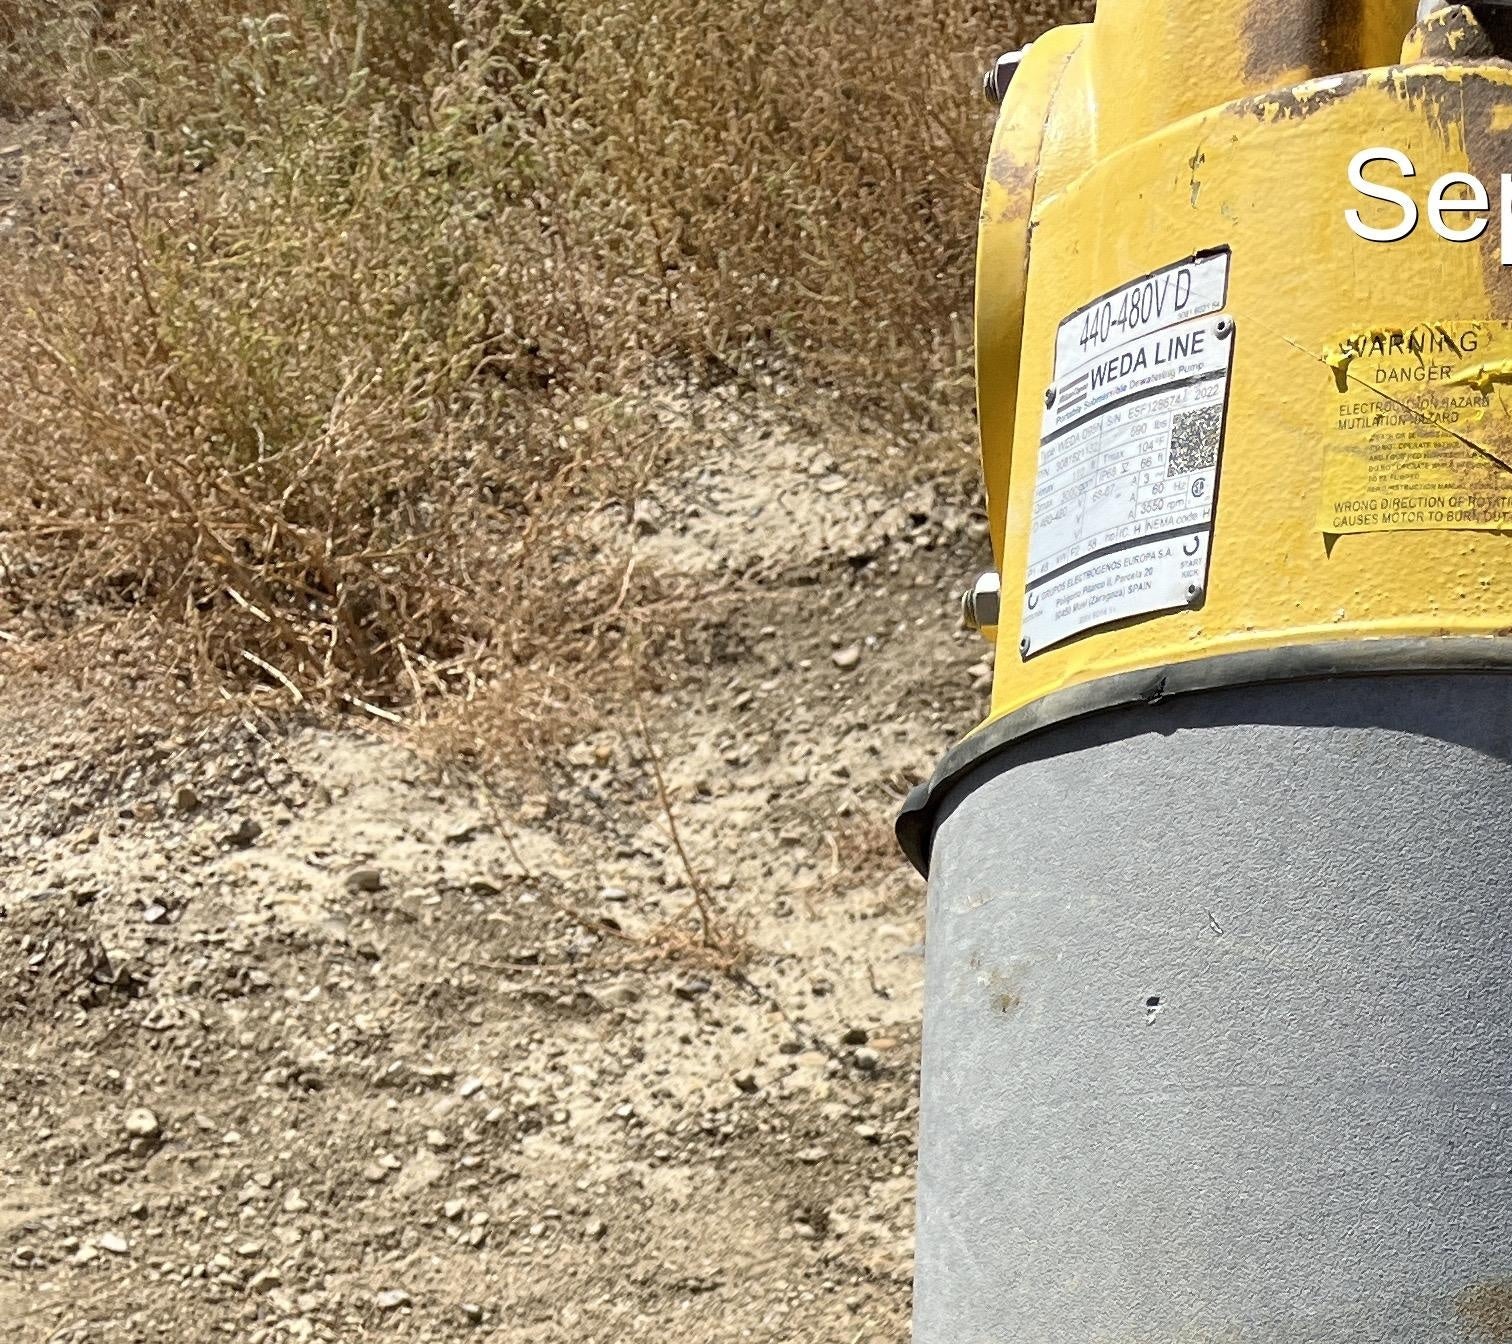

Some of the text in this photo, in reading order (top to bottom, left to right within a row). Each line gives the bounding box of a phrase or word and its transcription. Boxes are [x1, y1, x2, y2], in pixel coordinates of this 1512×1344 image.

[1079, 268, 1191, 353] 440-480V D
[1091, 330, 1206, 391] WEDA LINE
[1375, 364, 1452, 384] DANGER
[1194, 384, 1219, 401] 2022
[1139, 440, 1154, 454] 104
[1333, 499, 1378, 513] WRONG
[1380, 496, 1445, 511] DIRECTION
[1333, 513, 1379, 528] CAUSES
[1382, 511, 1424, 524] MOTOR
[1428, 510, 1444, 522] TO
[1144, 566, 1154, 578] 20
[1127, 580, 1153, 595] SPAIN
